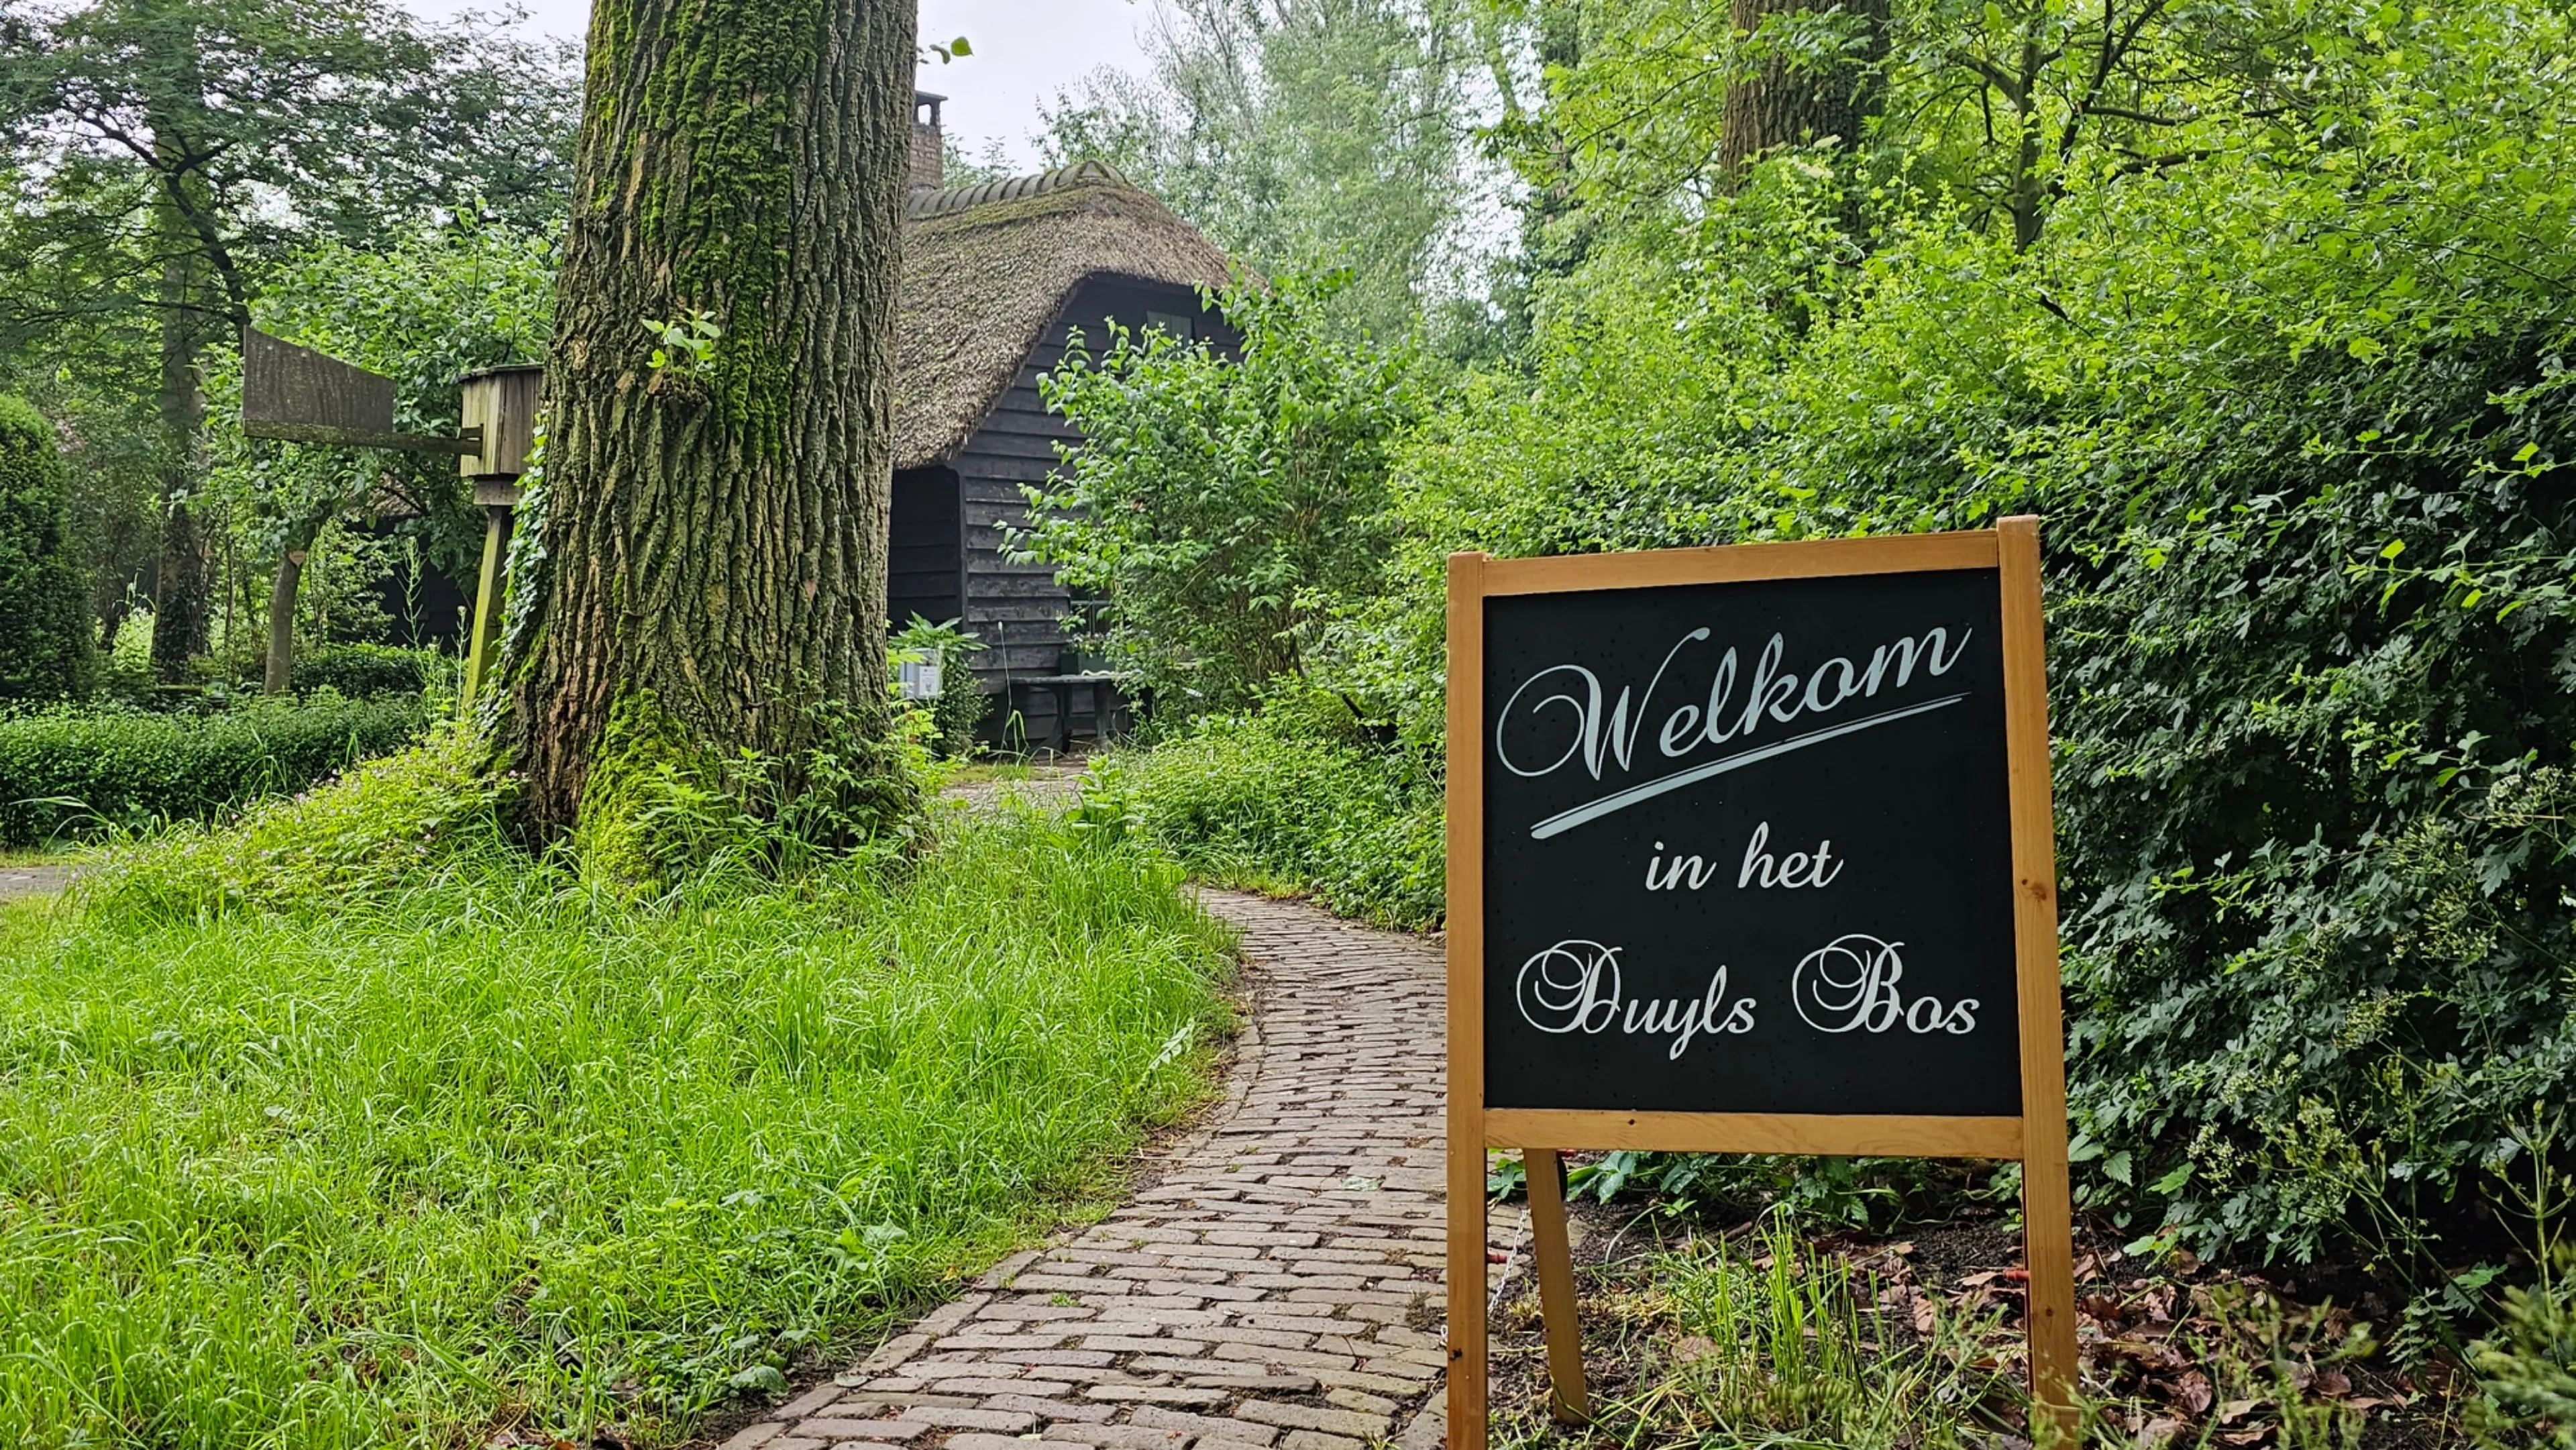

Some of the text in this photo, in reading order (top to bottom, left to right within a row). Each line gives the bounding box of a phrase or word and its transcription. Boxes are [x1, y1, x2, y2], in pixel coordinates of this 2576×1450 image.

[1497, 626, 1972, 779] Welkom
[1646, 821, 1844, 891] in het
[1516, 933, 1980, 1060] Duyls Bos
